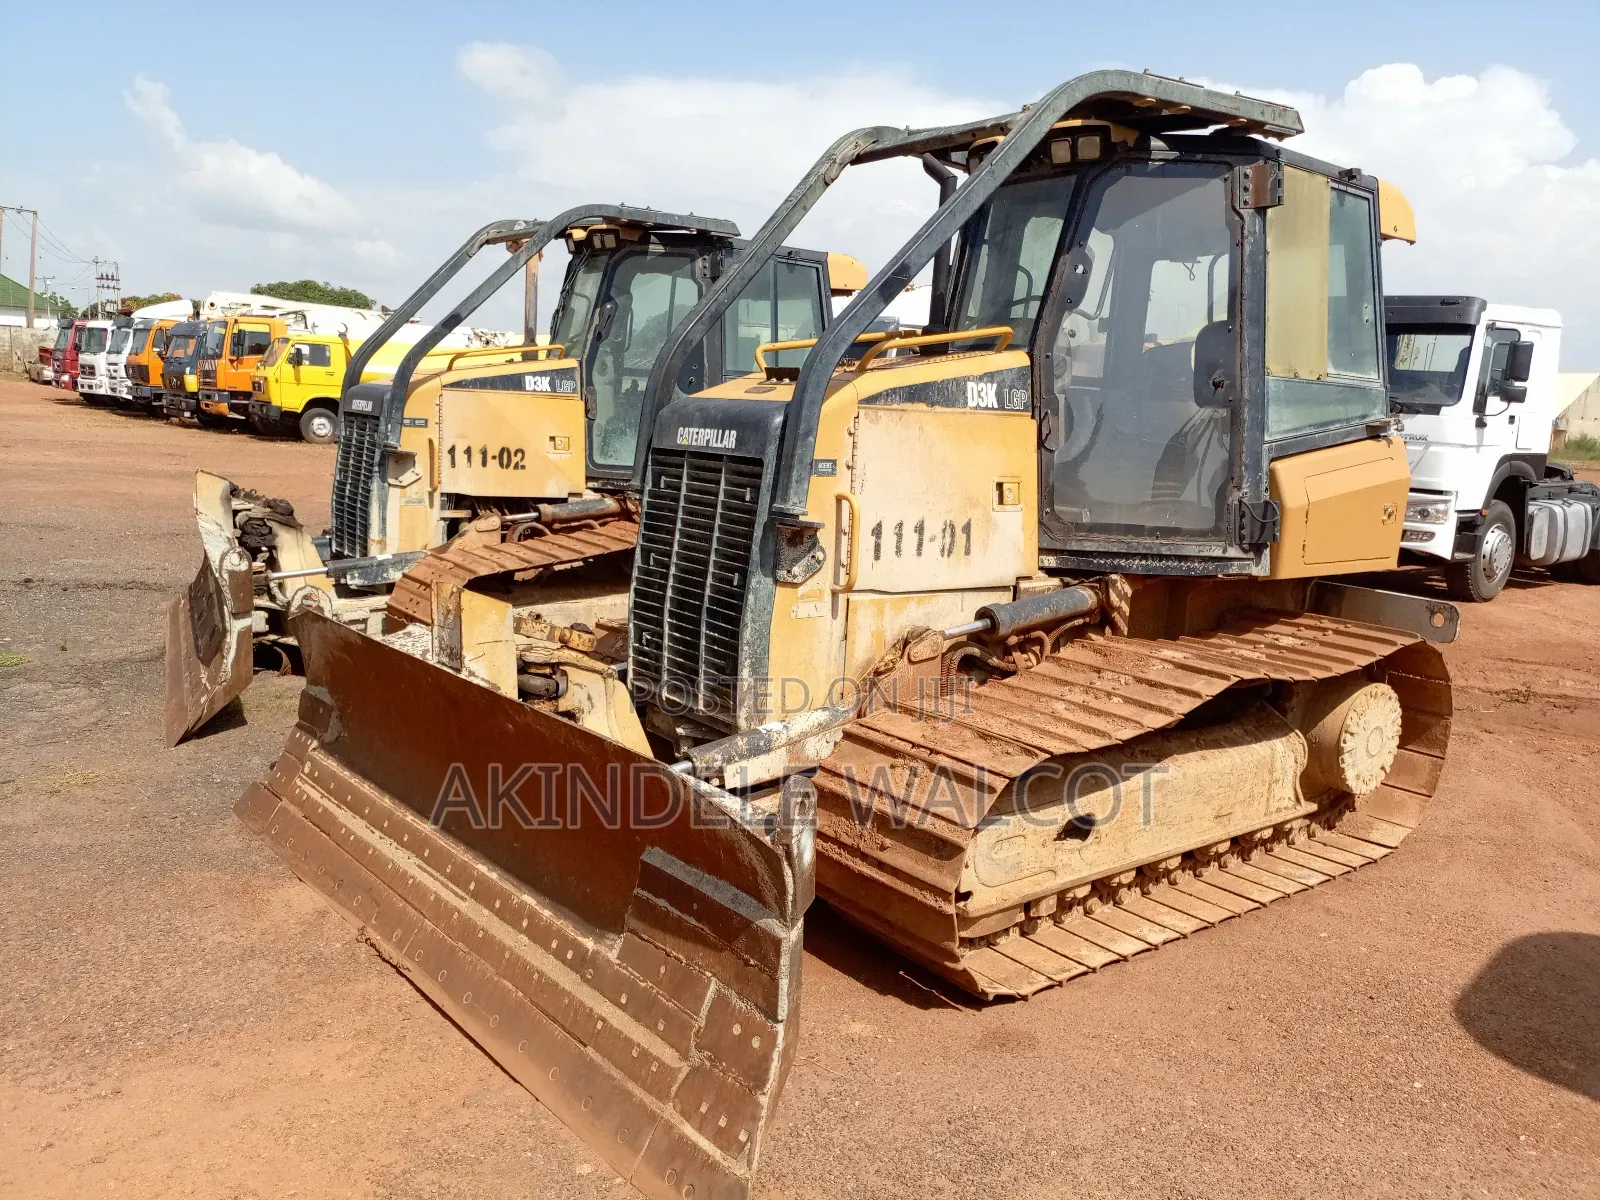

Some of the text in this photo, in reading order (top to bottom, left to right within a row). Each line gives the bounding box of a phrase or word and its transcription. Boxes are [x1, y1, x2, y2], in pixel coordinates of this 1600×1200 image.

[525, 375, 576, 393] D3K LGP
[966, 381, 1028, 410] D3K LGP
[676, 426, 737, 450] CATERPILLAR
[447, 444, 527, 471] 111-02
[870, 516, 973, 561] 111-01
